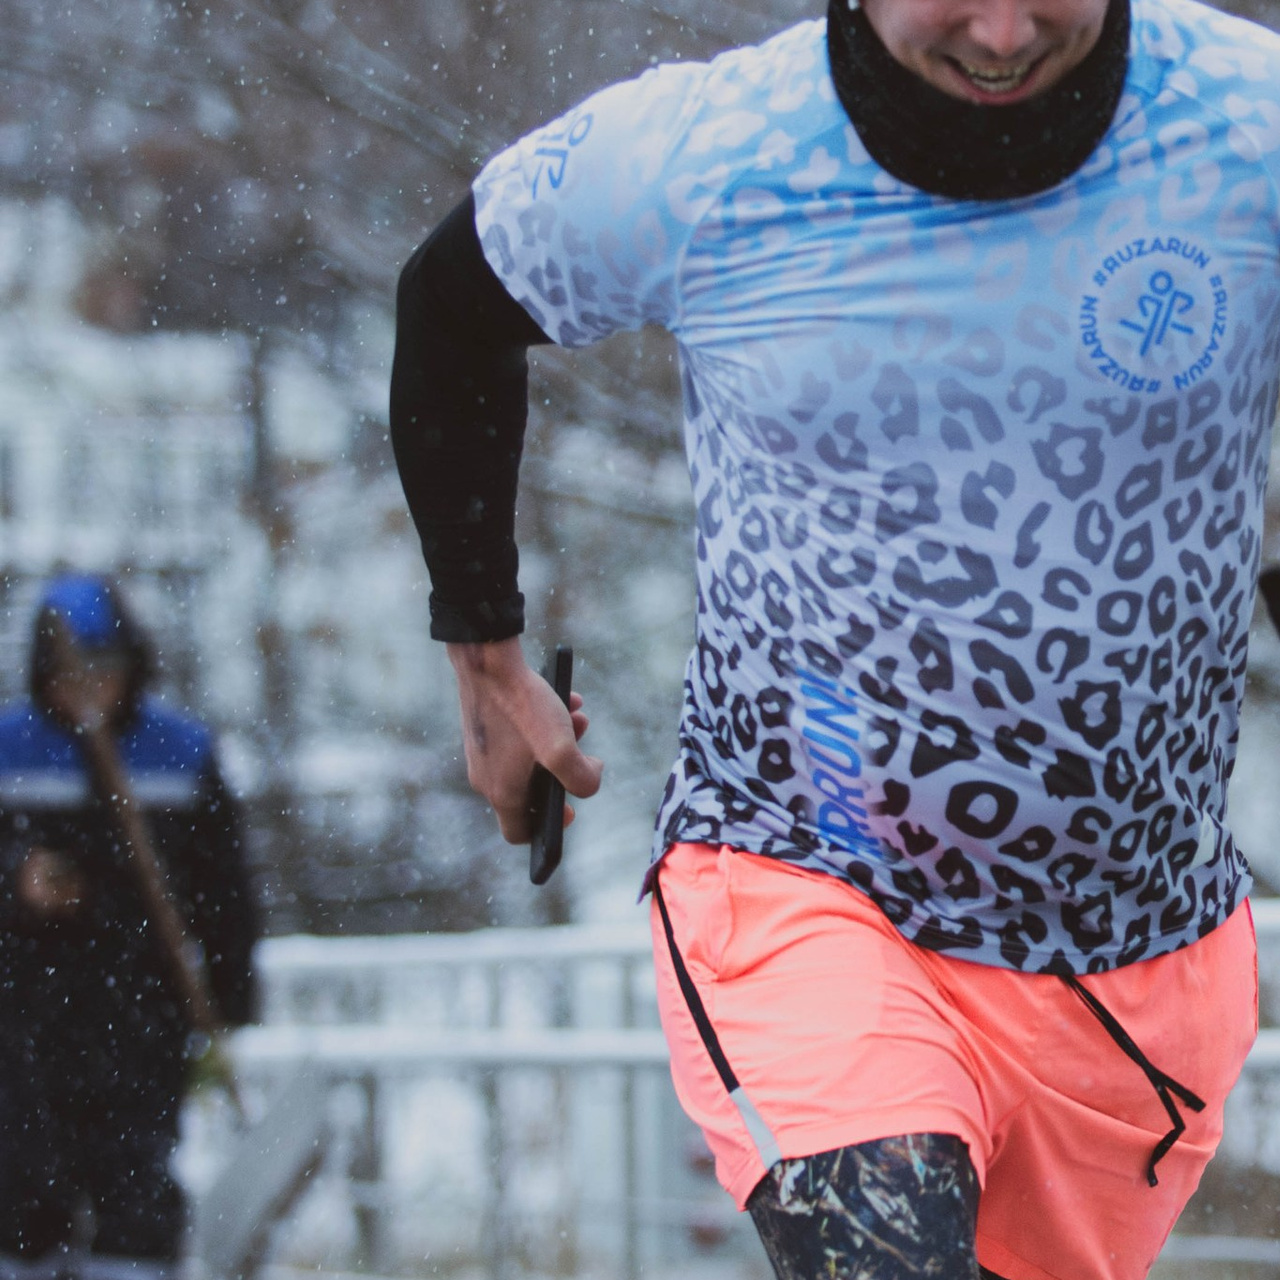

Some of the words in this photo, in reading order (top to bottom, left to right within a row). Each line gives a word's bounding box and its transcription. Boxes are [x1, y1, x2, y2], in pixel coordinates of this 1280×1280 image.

[1092, 237, 1211, 287] #RUZARUN
[1080, 295, 1161, 393] #RUZARUN
[1173, 274, 1227, 390] #RUZARUN
